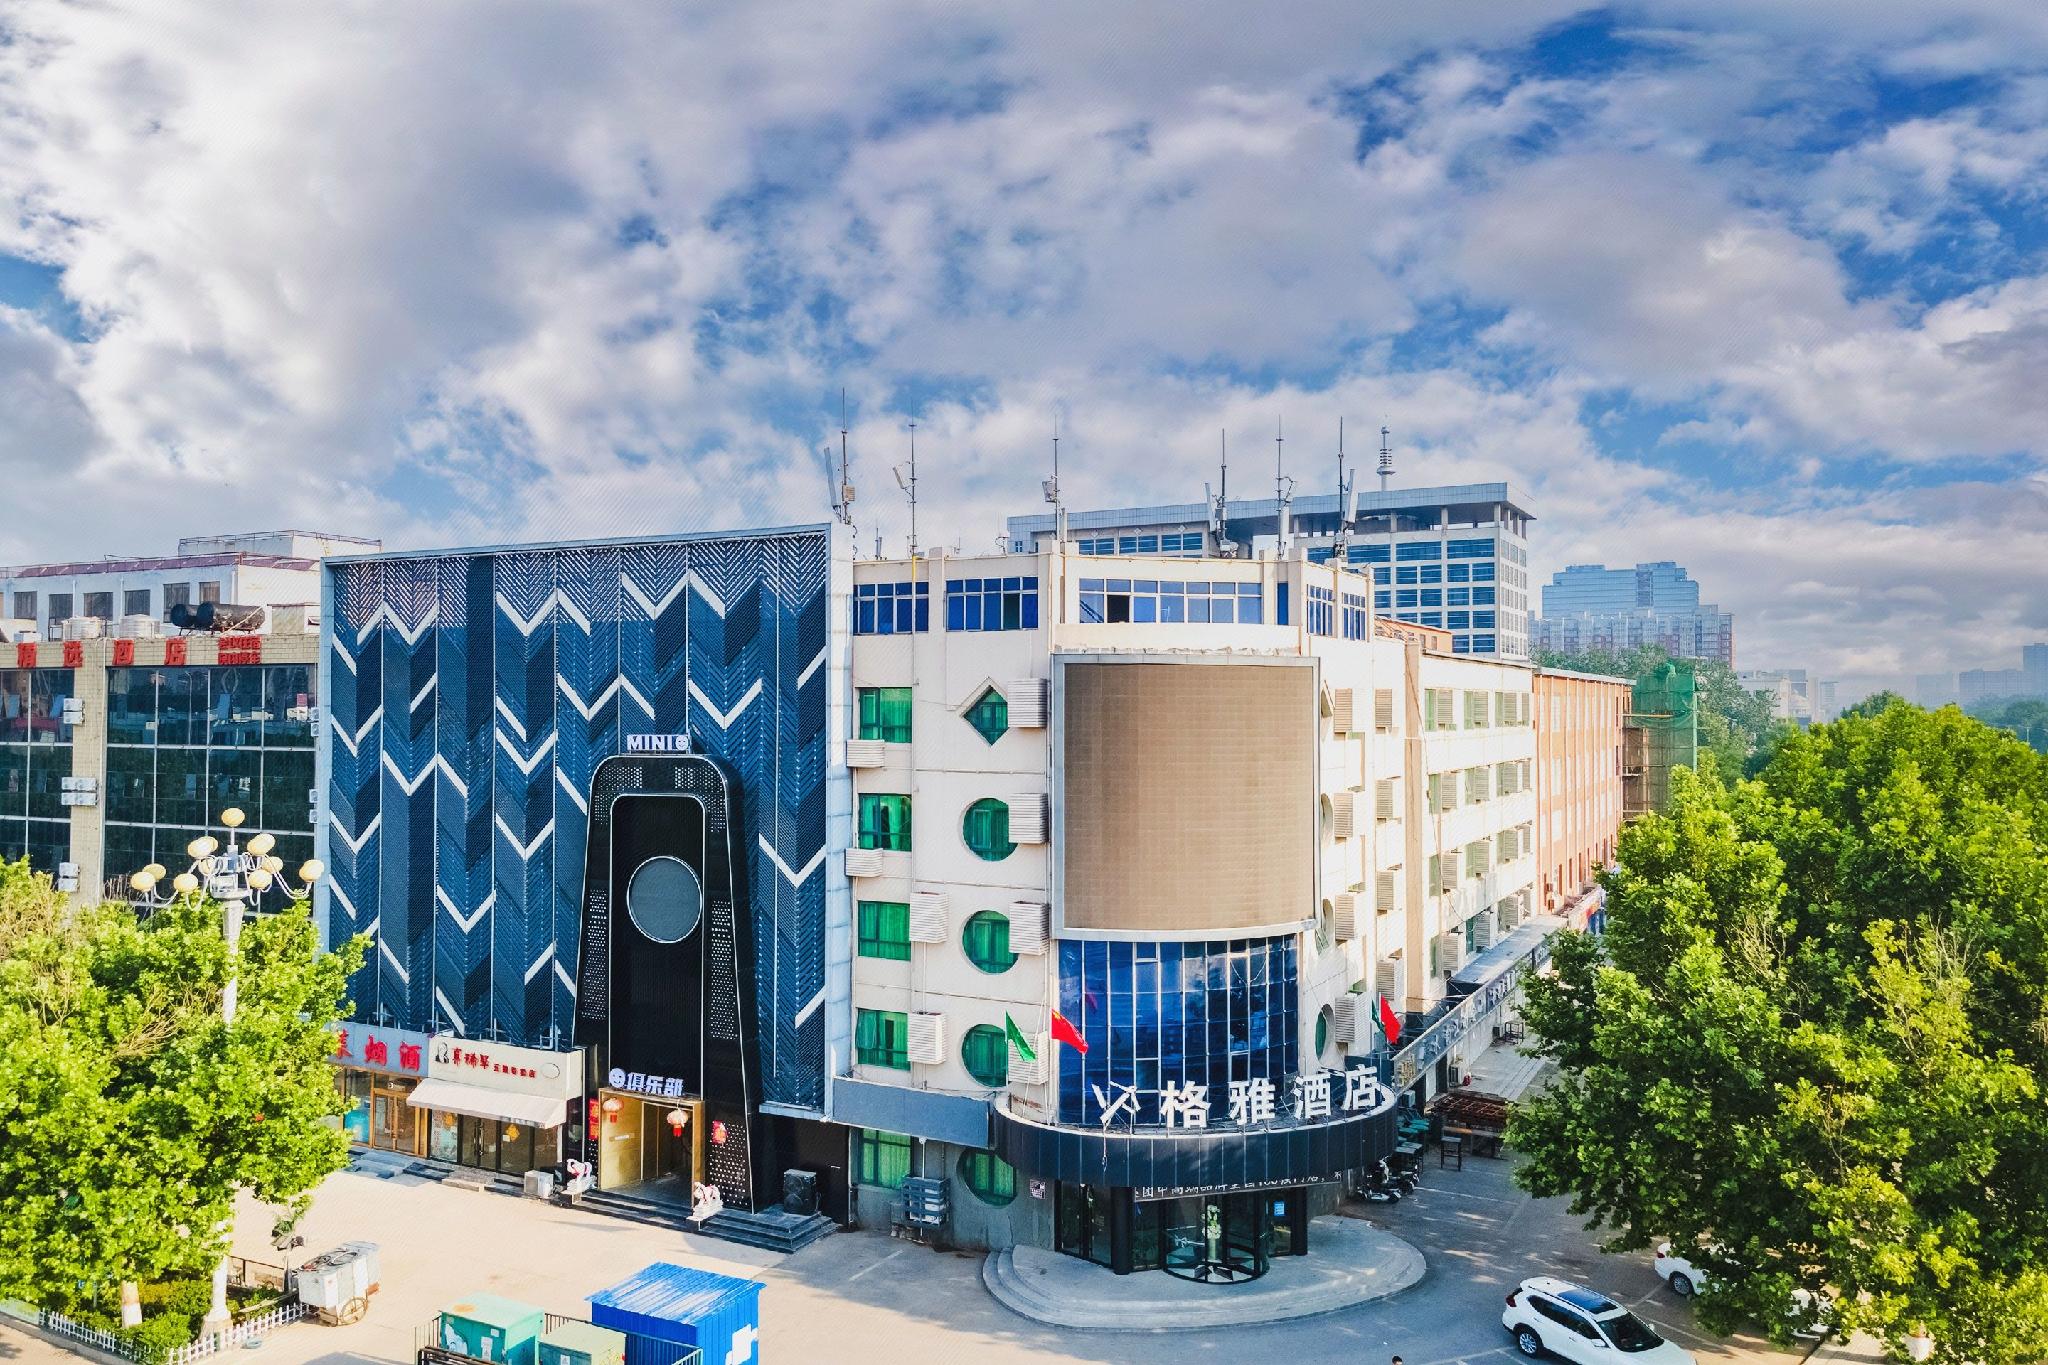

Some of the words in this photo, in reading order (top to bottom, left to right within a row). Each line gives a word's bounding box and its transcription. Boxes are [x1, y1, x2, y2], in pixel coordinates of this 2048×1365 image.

[16, 636, 187, 668] 精选酒店
[627, 1072, 684, 1096] 俱乐部
[1160, 1064, 1380, 1128] 格雅酒店
